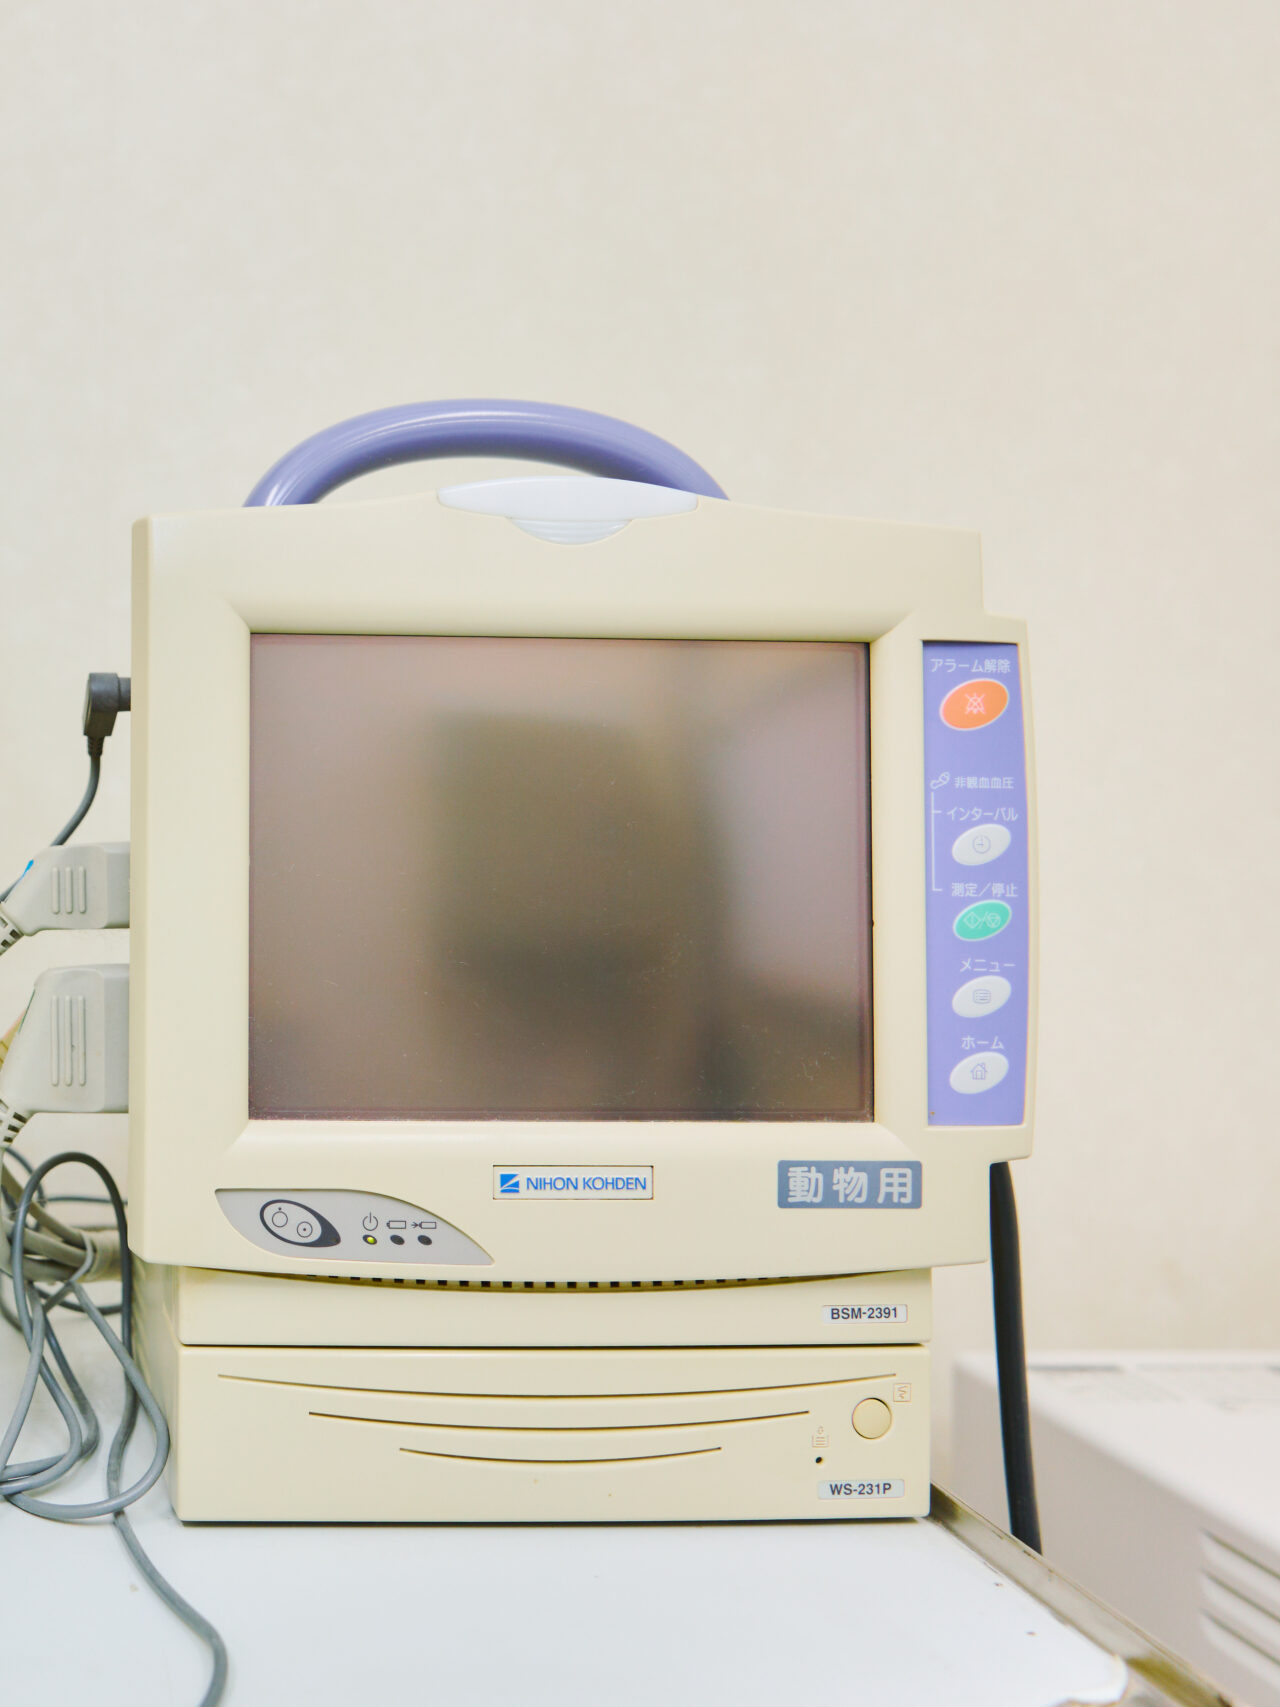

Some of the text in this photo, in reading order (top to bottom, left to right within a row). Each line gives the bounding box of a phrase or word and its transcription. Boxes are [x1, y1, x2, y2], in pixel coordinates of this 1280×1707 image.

[930, 658, 1011, 674] アラーム解除
[946, 807, 1018, 822] インターバル
[960, 958, 1016, 973] メニュー
[961, 1035, 1004, 1050] ホーム
[526, 1176, 647, 1190] NIHON KOHDEN
[786, 1166, 914, 1204] 動物用
[831, 1307, 898, 1319] BSM-2391
[829, 1483, 892, 1495] WS-231P
